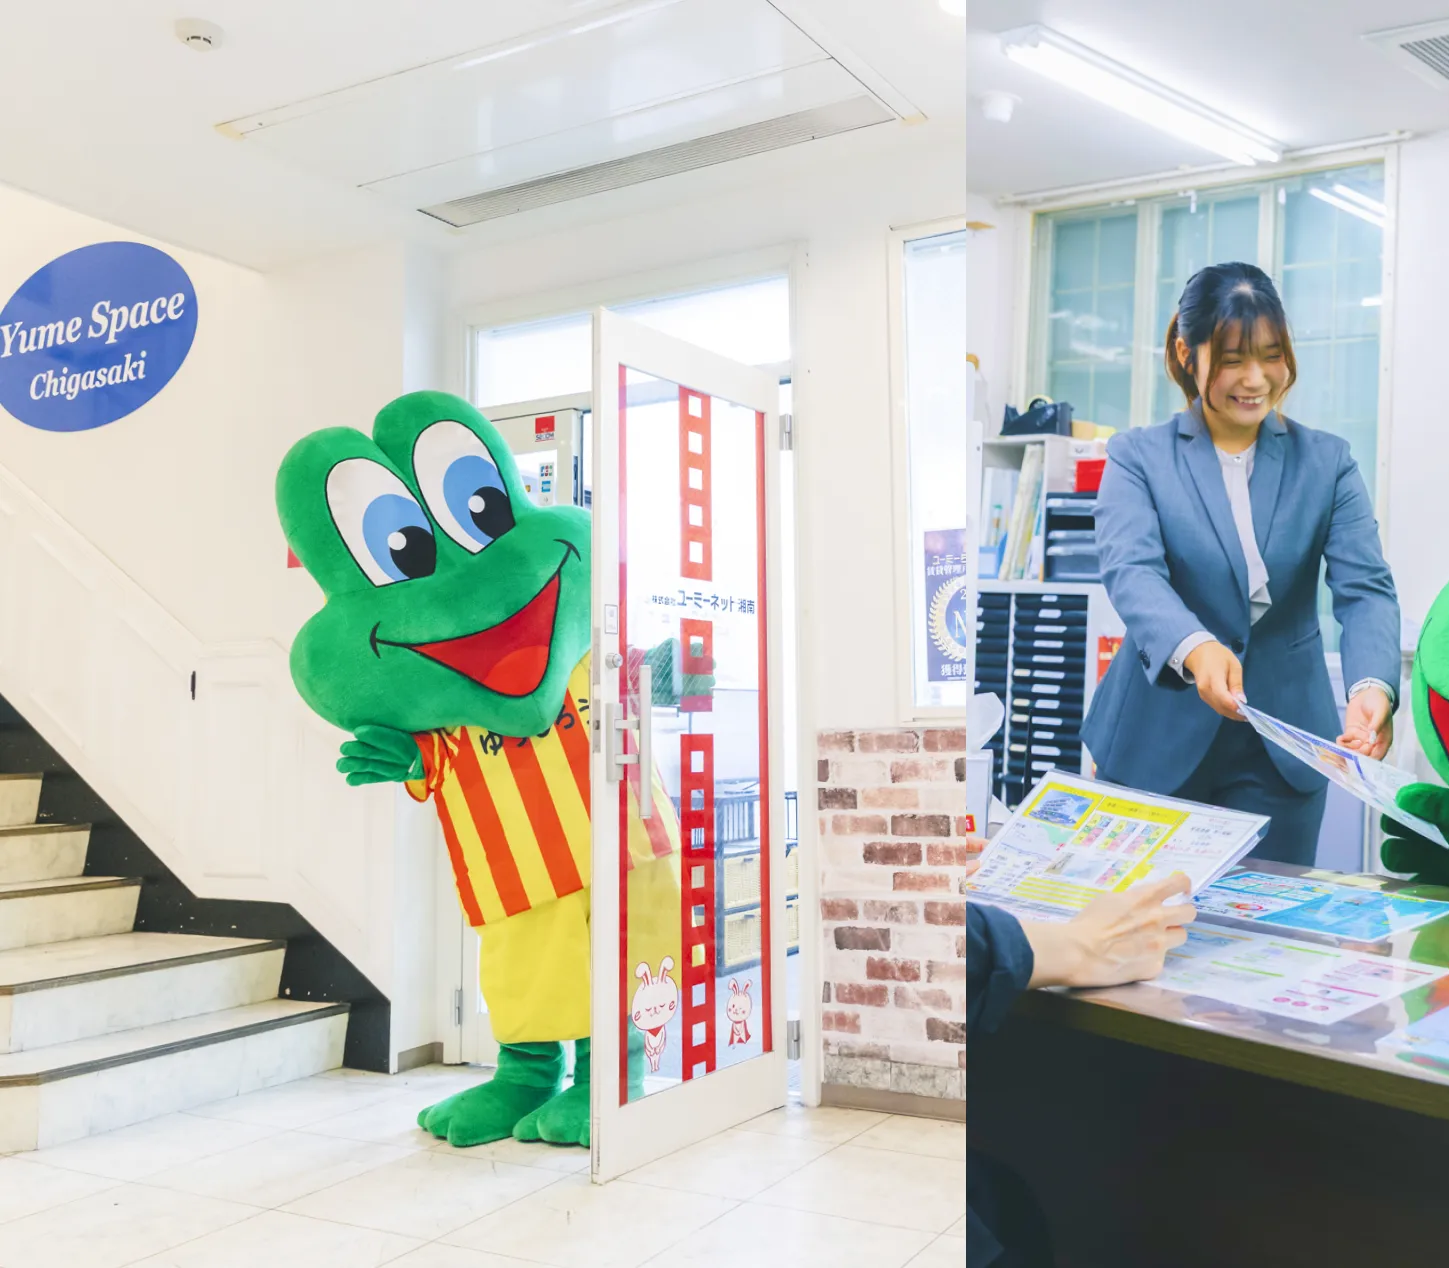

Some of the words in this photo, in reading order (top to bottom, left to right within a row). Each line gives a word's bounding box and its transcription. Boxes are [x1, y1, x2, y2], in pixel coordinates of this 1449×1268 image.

[0, 316, 83, 358] Yume
[88, 292, 185, 345] Space
[29, 350, 147, 401] Chigasaki
[940, 663, 966, 677] 獲得
